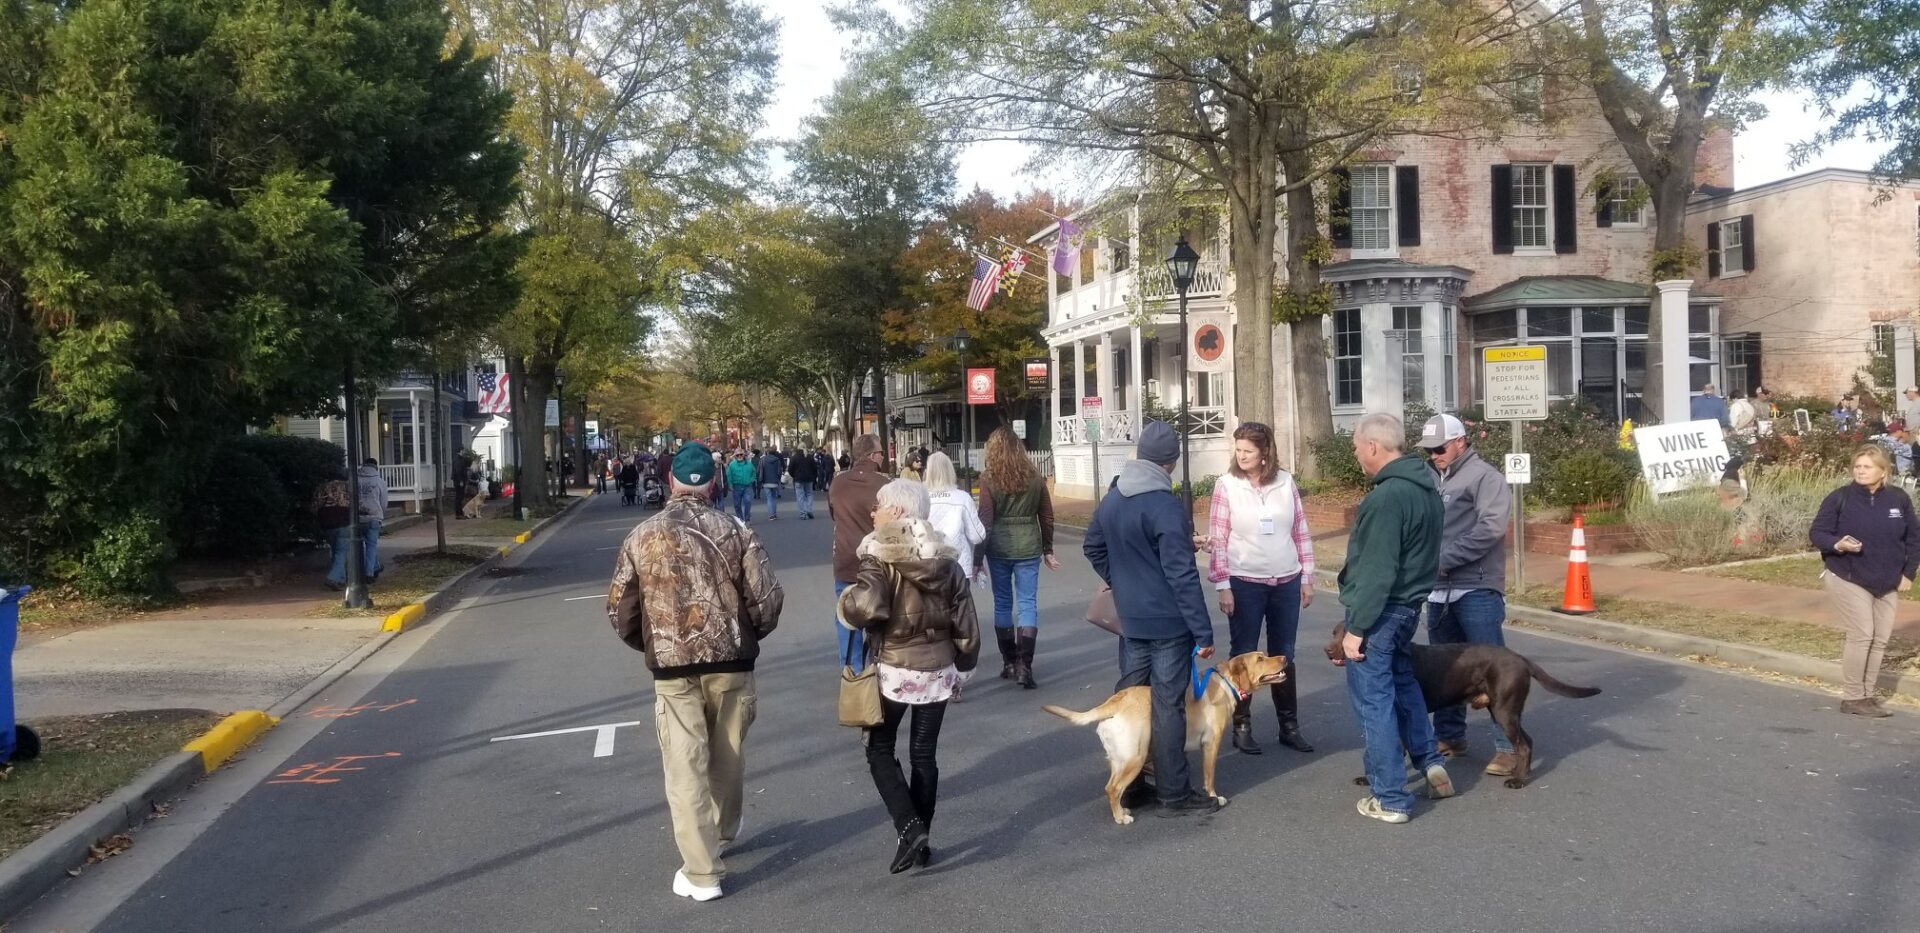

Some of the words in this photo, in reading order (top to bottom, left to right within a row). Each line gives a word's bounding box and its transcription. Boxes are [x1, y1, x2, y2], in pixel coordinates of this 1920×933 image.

[1500, 350, 1529, 359] NOTICE
[1495, 365, 1517, 373] STOP
[1518, 364, 1535, 372] FOR
[1490, 374, 1540, 383] PEDESTRIANS
[1492, 394, 1540, 402] CROSSWALKS
[1494, 408, 1518, 416] STATE
[1657, 431, 1709, 453] WINE
[1647, 455, 1727, 480] TASTING
